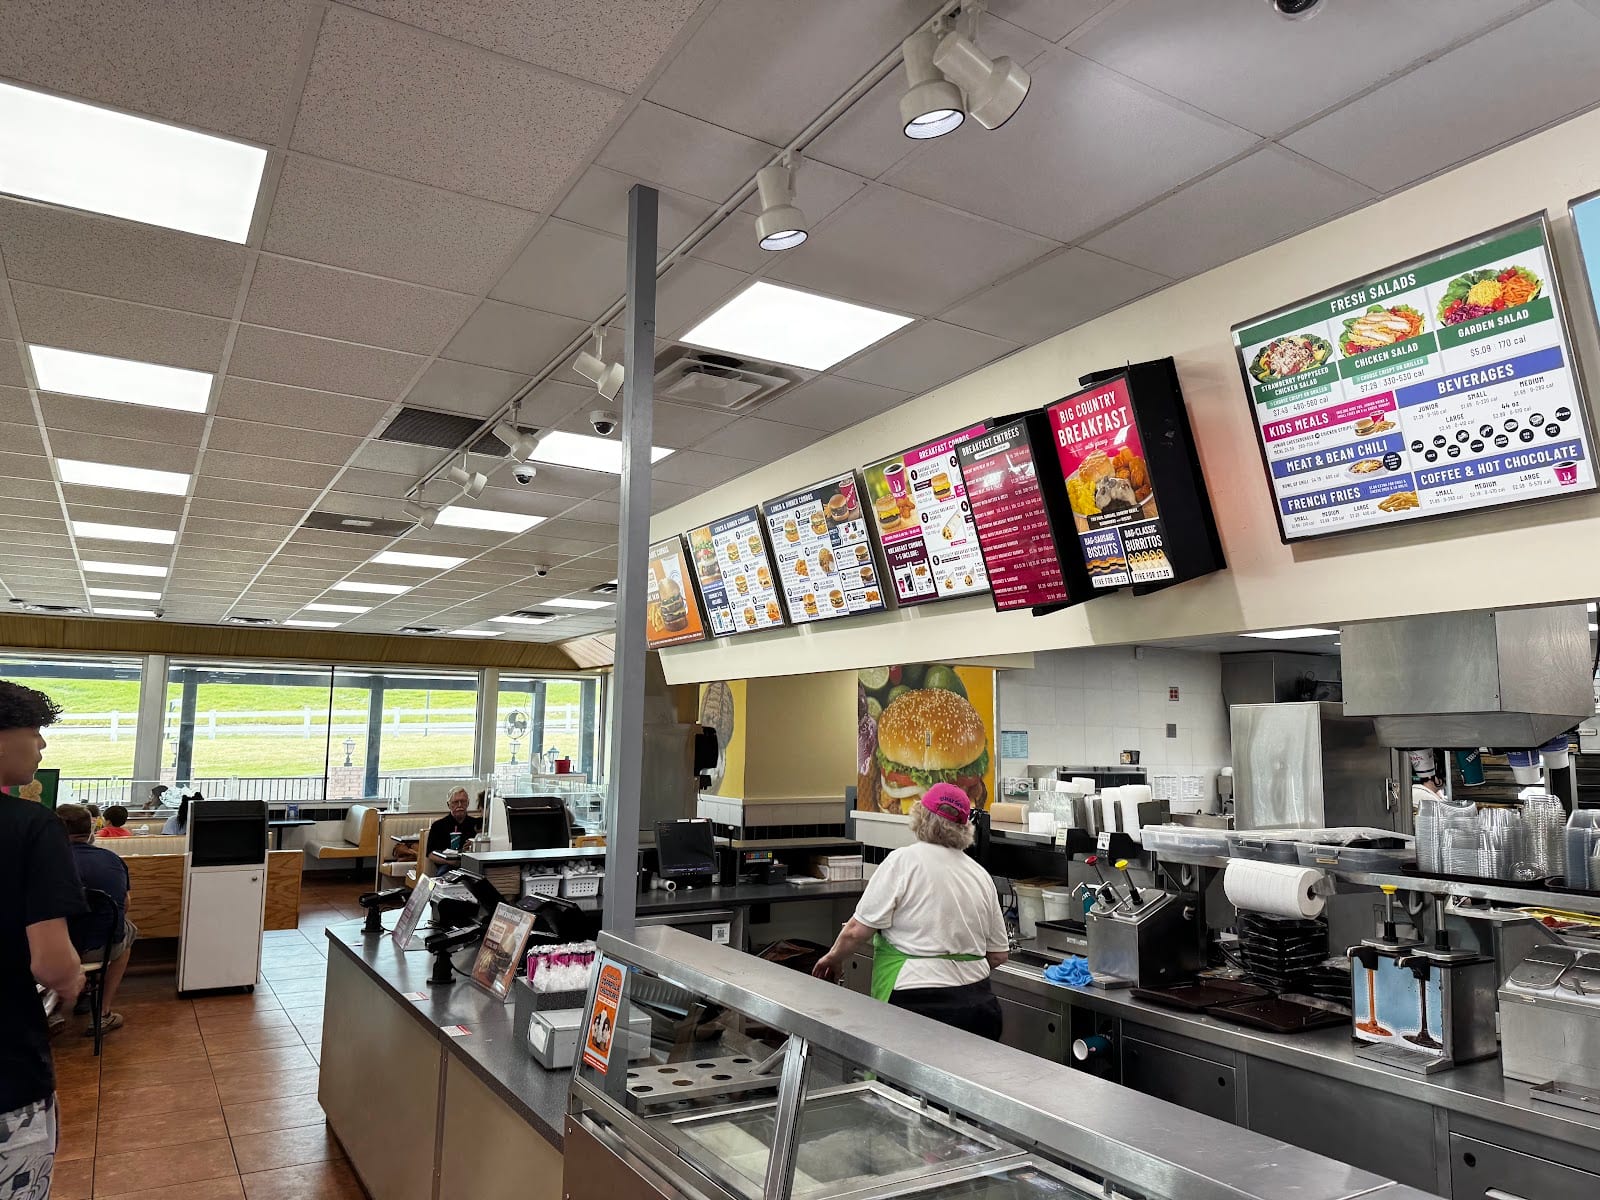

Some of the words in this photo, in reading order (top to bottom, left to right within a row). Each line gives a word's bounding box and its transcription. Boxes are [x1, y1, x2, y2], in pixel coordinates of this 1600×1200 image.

[1330, 290, 1368, 313] FRESH
[1369, 272, 1417, 300] SALADS
[1458, 319, 1495, 339] GARDEN
[1497, 308, 1530, 327] SALAD
[1513, 334, 1526, 345] cal
[1354, 351, 1390, 369] CHICKEN
[1391, 342, 1419, 358] SALAD
[1261, 377, 1295, 393] STRAWBERRY
[1297, 367, 1329, 382] POPPYSEED
[1413, 368, 1425, 378] cal
[1437, 363, 1515, 395] BEVERAGES
[1275, 384, 1298, 396] CHICKEN
[1299, 378, 1318, 389] SALAD
[1519, 377, 1545, 388] MEDIUM
[1319, 395, 1329, 405] cal
[1468, 391, 1488, 401] SMALL
[1059, 407, 1075, 423] BIG
[1076, 391, 1116, 417] COUNTRY
[1418, 403, 1439, 413] JUNIOR
[1501, 402, 1510, 410] 44
[1058, 406, 1129, 447] BREAKFAST
[1269, 422, 1295, 437] KIDS
[1295, 413, 1330, 431] MEALS
[1445, 413, 1465, 423] LARGE
[961, 437, 993, 458] BREAKFAST
[993, 427, 1020, 446] ENTRÉES
[918, 444, 951, 460] BREAKFAST
[1286, 457, 1313, 473] MEAT
[1315, 454, 1324, 466] &
[1325, 447, 1355, 464] BEAN
[1357, 440, 1388, 457] CHILI
[1420, 467, 1462, 485] COFFEE
[1464, 465, 1475, 477] &
[1478, 460, 1502, 475] HOT
[1504, 445, 1579, 470] CHOCOLATE
[1474, 481, 1497, 489] MEDIUM
[1520, 473, 1540, 481] LARGE
[1288, 493, 1328, 511] FRENCH
[1330, 487, 1362, 503] FRIES
[1086, 542, 1119, 559] BISCUITS
[1125, 534, 1163, 552] BURRITOS
